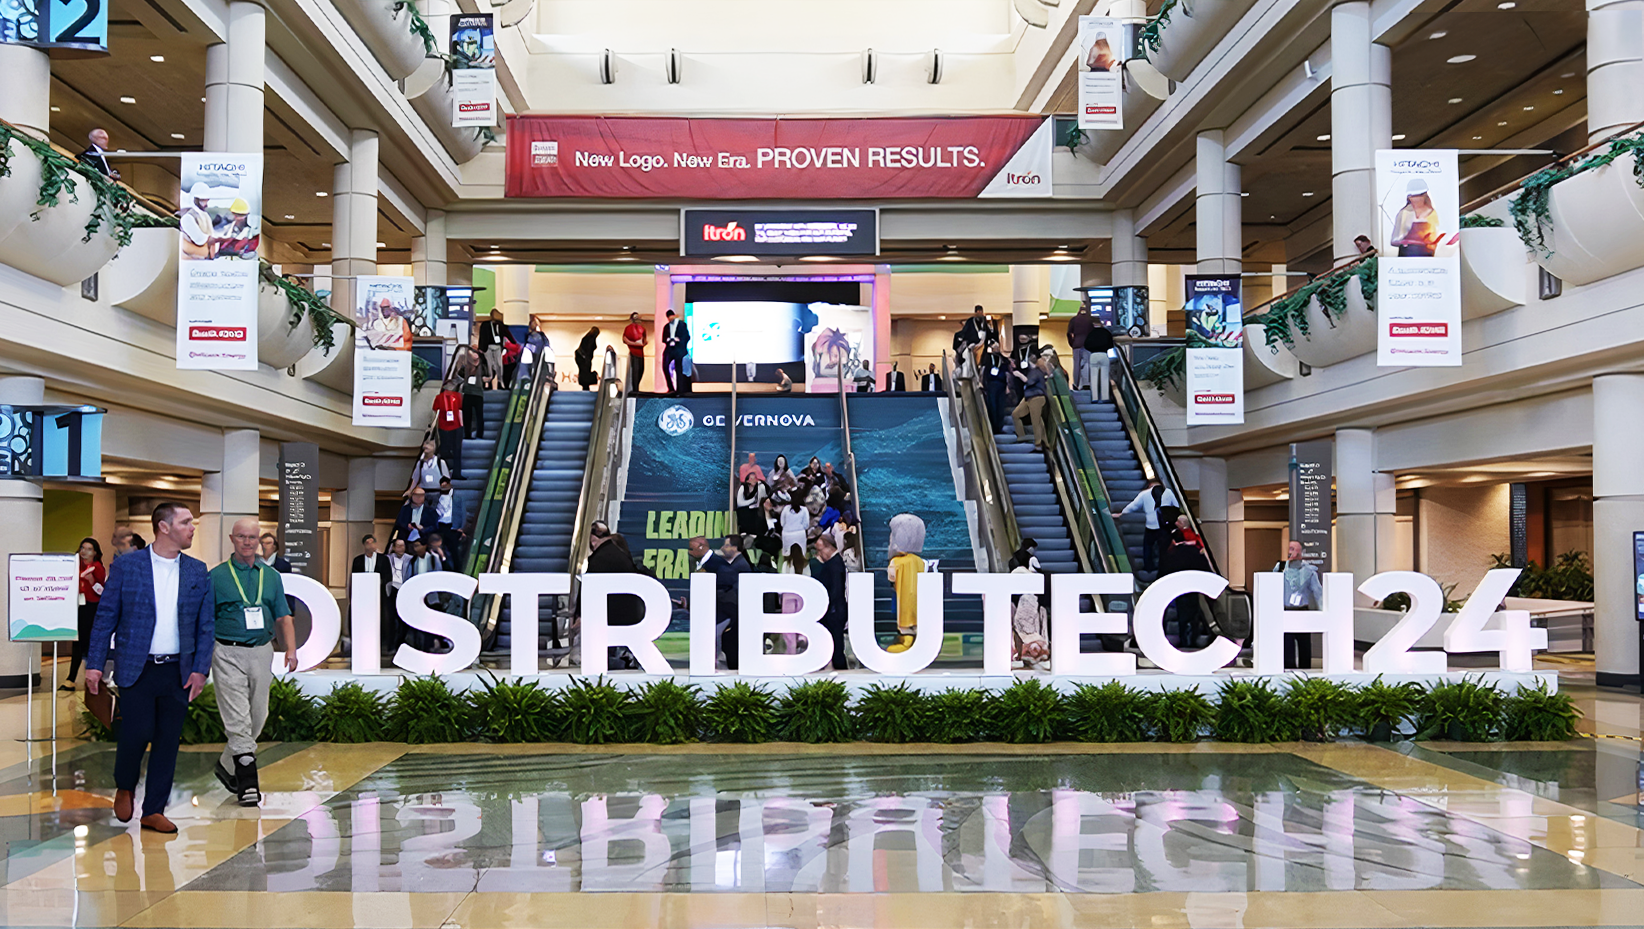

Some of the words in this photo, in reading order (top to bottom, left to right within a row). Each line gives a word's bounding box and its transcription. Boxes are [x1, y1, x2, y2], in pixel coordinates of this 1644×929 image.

[54, 0, 101, 44] 2
[575, 151, 615, 168] New
[619, 151, 669, 172] Logo.
[673, 151, 713, 168] New
[717, 152, 751, 169] Era.
[757, 147, 860, 169] PROVEN
[868, 146, 986, 168] RESULTS.
[1006, 171, 1041, 185] Itron
[703, 222, 746, 241] Itron
[54, 411, 83, 476] 1
[645, 510, 738, 539] LEADIN
[271, 568, 1548, 678] DISTRIBUTECH24
